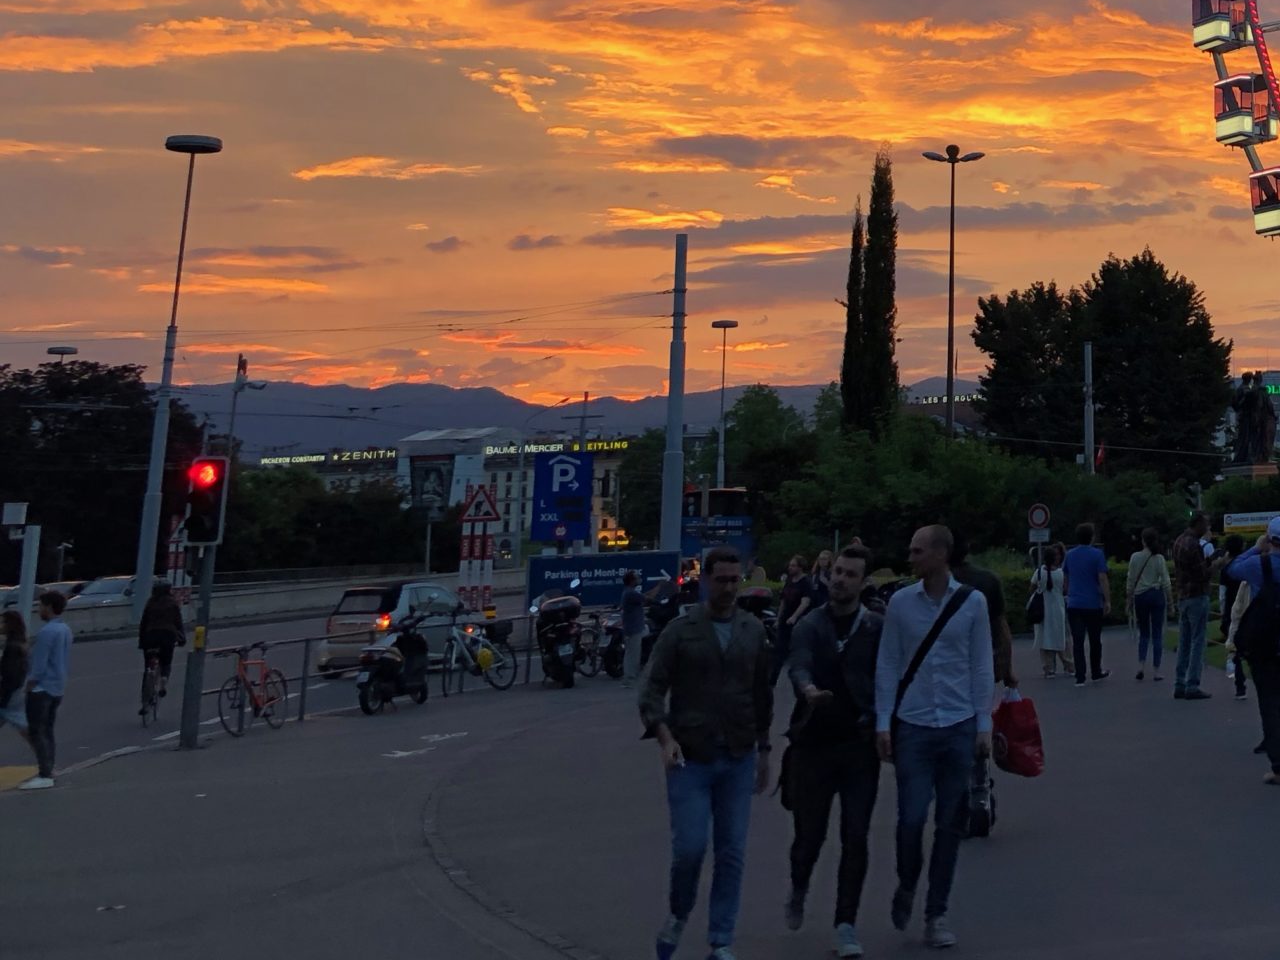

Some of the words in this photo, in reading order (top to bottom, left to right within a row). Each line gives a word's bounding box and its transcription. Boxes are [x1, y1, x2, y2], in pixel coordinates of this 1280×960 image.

[485, 445, 517, 454] BAUME
[525, 443, 564, 453] MERCIER
[573, 441, 628, 451] BEITLING
[341, 450, 396, 460] ZENITH
[552, 463, 576, 492] P
[540, 500, 547, 508] L
[540, 513, 559, 522] XXL
[544, 570, 579, 580] Parking
[581, 568, 592, 578] du
[594, 567, 643, 577] Mont-Blc
